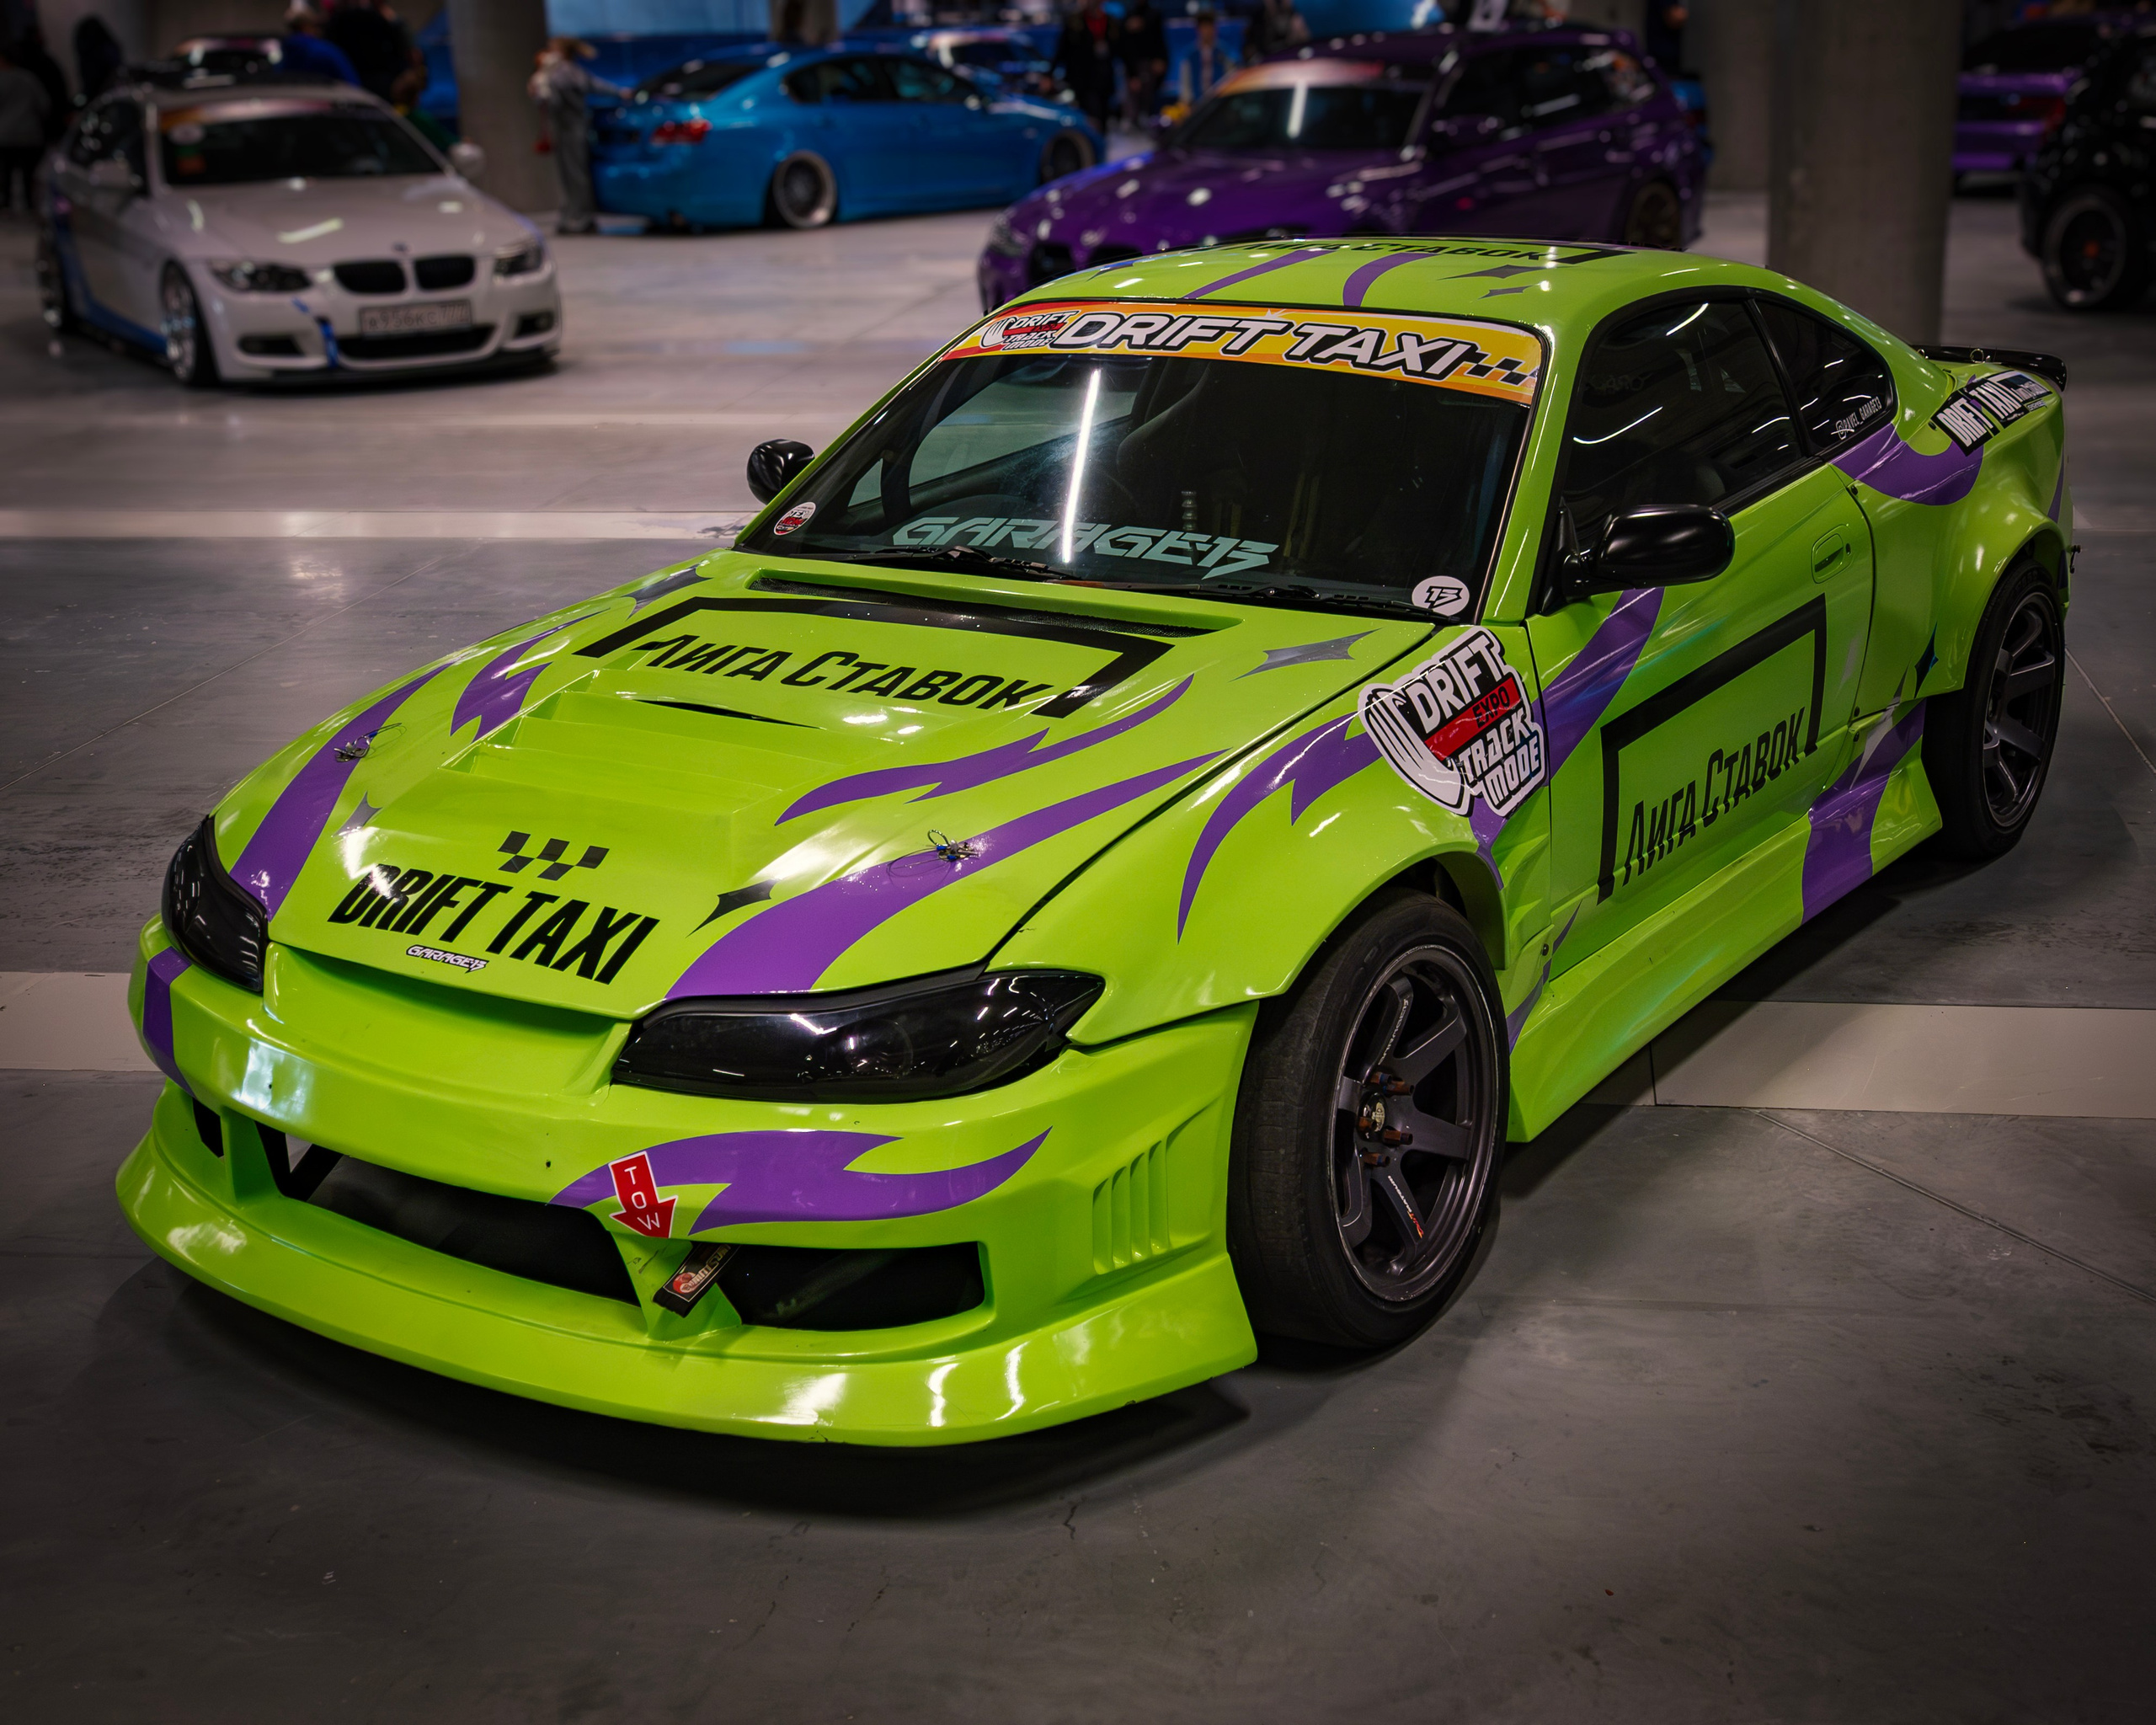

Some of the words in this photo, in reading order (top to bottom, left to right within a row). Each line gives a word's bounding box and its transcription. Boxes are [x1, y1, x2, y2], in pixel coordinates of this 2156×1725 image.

[1006, 331, 1057, 342] TRACK
[1008, 312, 1078, 329] DRIFT
[1053, 312, 1294, 359] DRIFT
[1282, 323, 1481, 381] TAXI
[1936, 397, 1993, 447] DRIFT
[1968, 382, 2023, 419] TAXI
[632, 633, 793, 681] ЛИГА
[780, 650, 1054, 711] СТАВОК
[1406, 633, 1502, 734] DRIFT
[1472, 685, 1511, 729] EXPO
[1458, 708, 1530, 784] TRACK
[1484, 734, 1540, 806] MODE
[1621, 779, 1696, 888] ЛИГА
[1701, 706, 1806, 828] СТАВОК
[327, 863, 514, 943] DRIFT
[485, 890, 660, 985] TAXI
[624, 1166, 660, 1231] TOW
